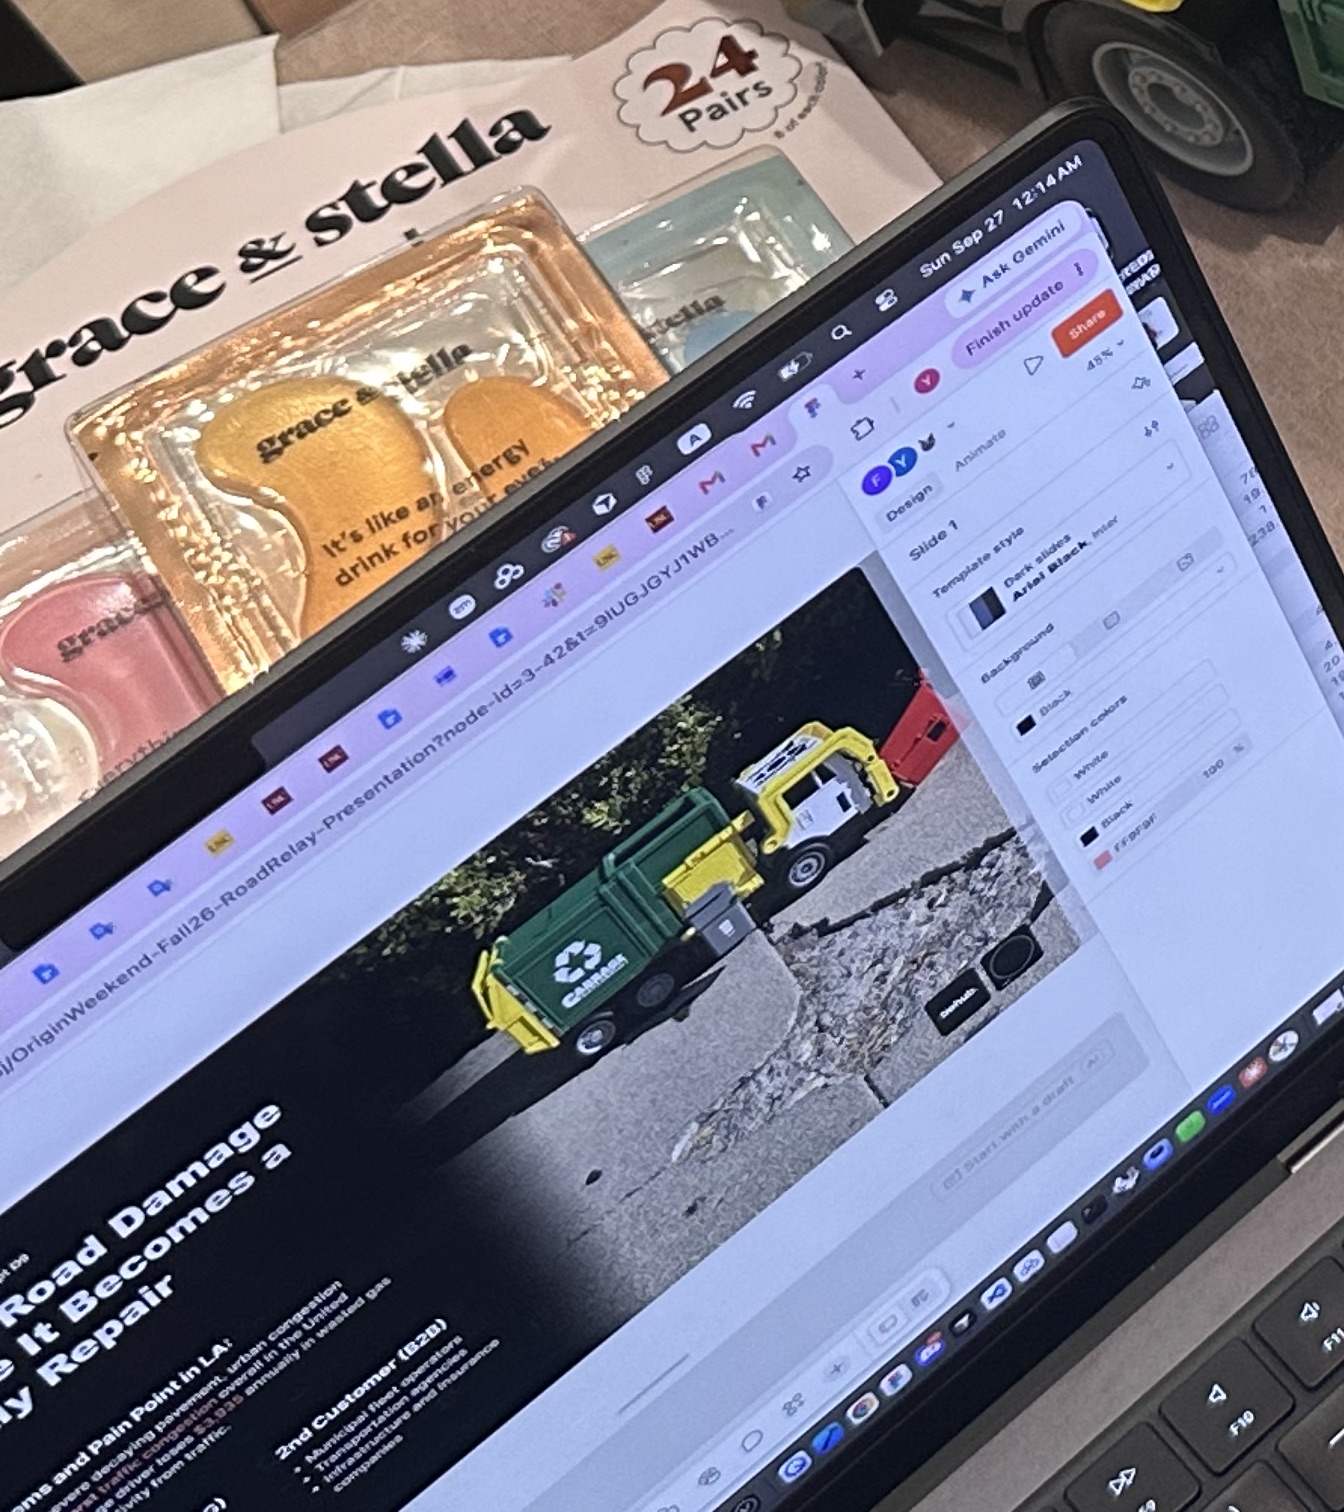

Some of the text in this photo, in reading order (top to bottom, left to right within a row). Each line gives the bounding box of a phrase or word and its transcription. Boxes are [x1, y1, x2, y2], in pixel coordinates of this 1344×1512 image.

[642, 34, 760, 117] 24
[678, 79, 774, 133] Pairs
[238, 230, 304, 282] &
[304, 100, 553, 248] stella
[920, 153, 1083, 279] Sun Sep 27 12:14AM
[979, 218, 1065, 288] Ask Gemini
[965, 279, 1064, 356] Finish update
[1069, 307, 1106, 340] Share
[255, 398, 353, 464] grace
[396, 343, 473, 394] tella
[953, 427, 1006, 472] Animate
[321, 438, 532, 560] It's like an energy
[335, 496, 500, 588] drink for your
[885, 481, 934, 524] Design
[909, 518, 960, 563] Slide 1
[931, 525, 1025, 600] Template style
[1003, 531, 1072, 588] Dark slides
[1010, 570, 1045, 601] Arial
[1030, 693, 1127, 774] Selection colors
[0, 1100, 284, 1329] Road Damage
[16, 1321, 61, 1357] It
[58, 1166, 256, 1324] Becomes
[262, 1138, 292, 1169] a
[35, 1273, 174, 1387] Repair
[52, 1337, 234, 1487] and Pain Point in LA:
[90, 1279, 343, 1484] decaying pavement, urban congestion
[99, 1291, 350, 1496] traffic congestion overall in the United
[113, 1466, 157, 1504] driver
[155, 1435, 196, 1469] loses
[243, 1349, 303, 1399] annually
[299, 1336, 318, 1354] in
[314, 1295, 368, 1339] wasted
[364, 1275, 393, 1302] gas
[274, 1317, 449, 1461] 2nd Customer (B2B)
[304, 1333, 463, 1465] Municipal fleet operators
[314, 1346, 468, 1473] Transportation agencies
[322, 1336, 500, 1484] Infrastructure and insurance
[1226, 1408, 1257, 1440] F10
[150, 1423, 233, 1489] from traffic.
[332, 1432, 404, 1493] companies
